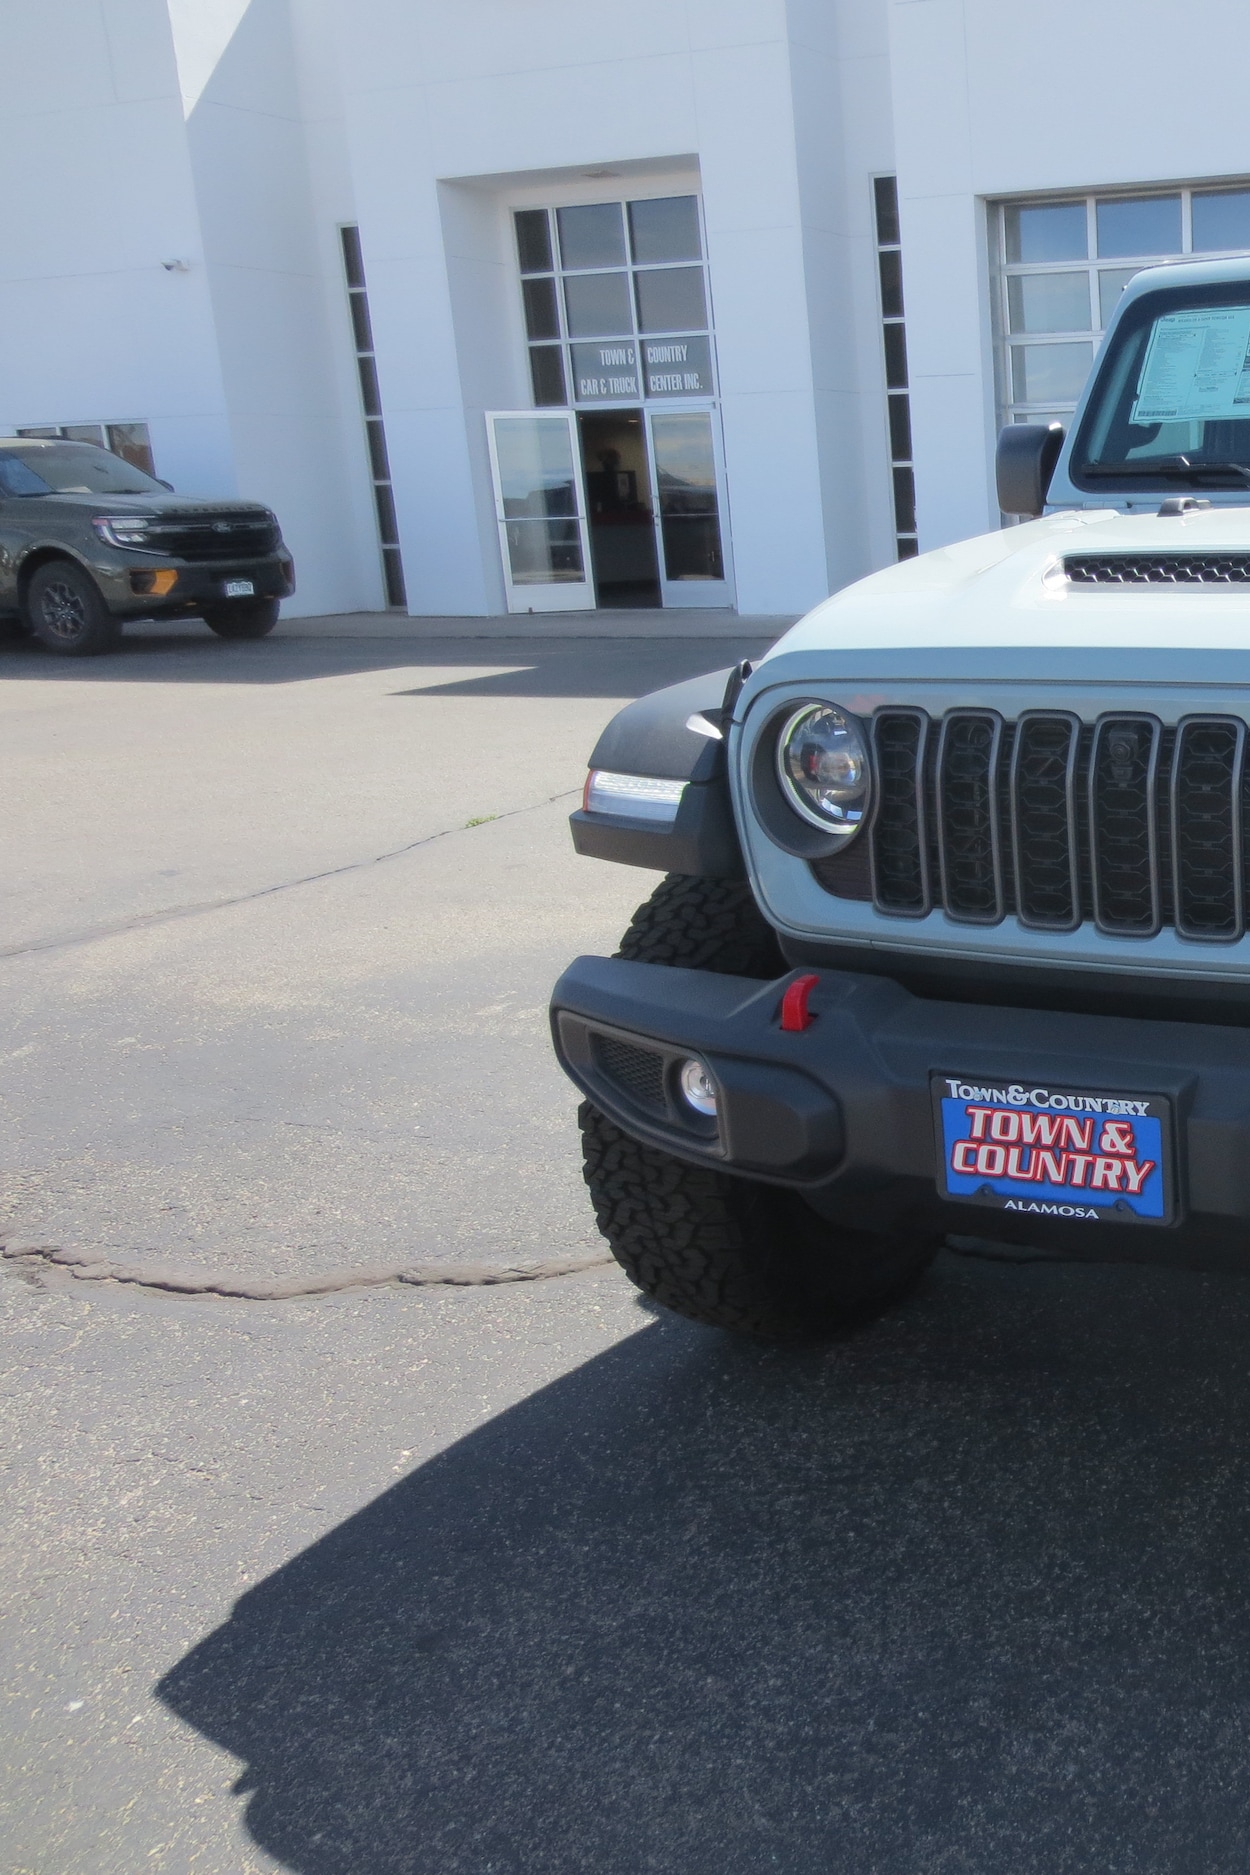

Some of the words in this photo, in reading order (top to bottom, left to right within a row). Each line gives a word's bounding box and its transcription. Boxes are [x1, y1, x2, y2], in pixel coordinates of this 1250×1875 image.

[600, 349, 626, 366] TOWN
[627, 348, 635, 364] &
[647, 345, 688, 364] COUNTRY
[581, 379, 599, 395] CAR
[601, 379, 607, 394] &
[609, 376, 638, 394] TRUCK
[649, 374, 683, 392] CENTER
[684, 372, 704, 390] INC.
[966, 1105, 1094, 1151] TOWN
[1100, 1119, 1136, 1156] &
[951, 1140, 1155, 1194] COUNTRY
[1004, 1199, 1100, 1220] ALAMOSA
